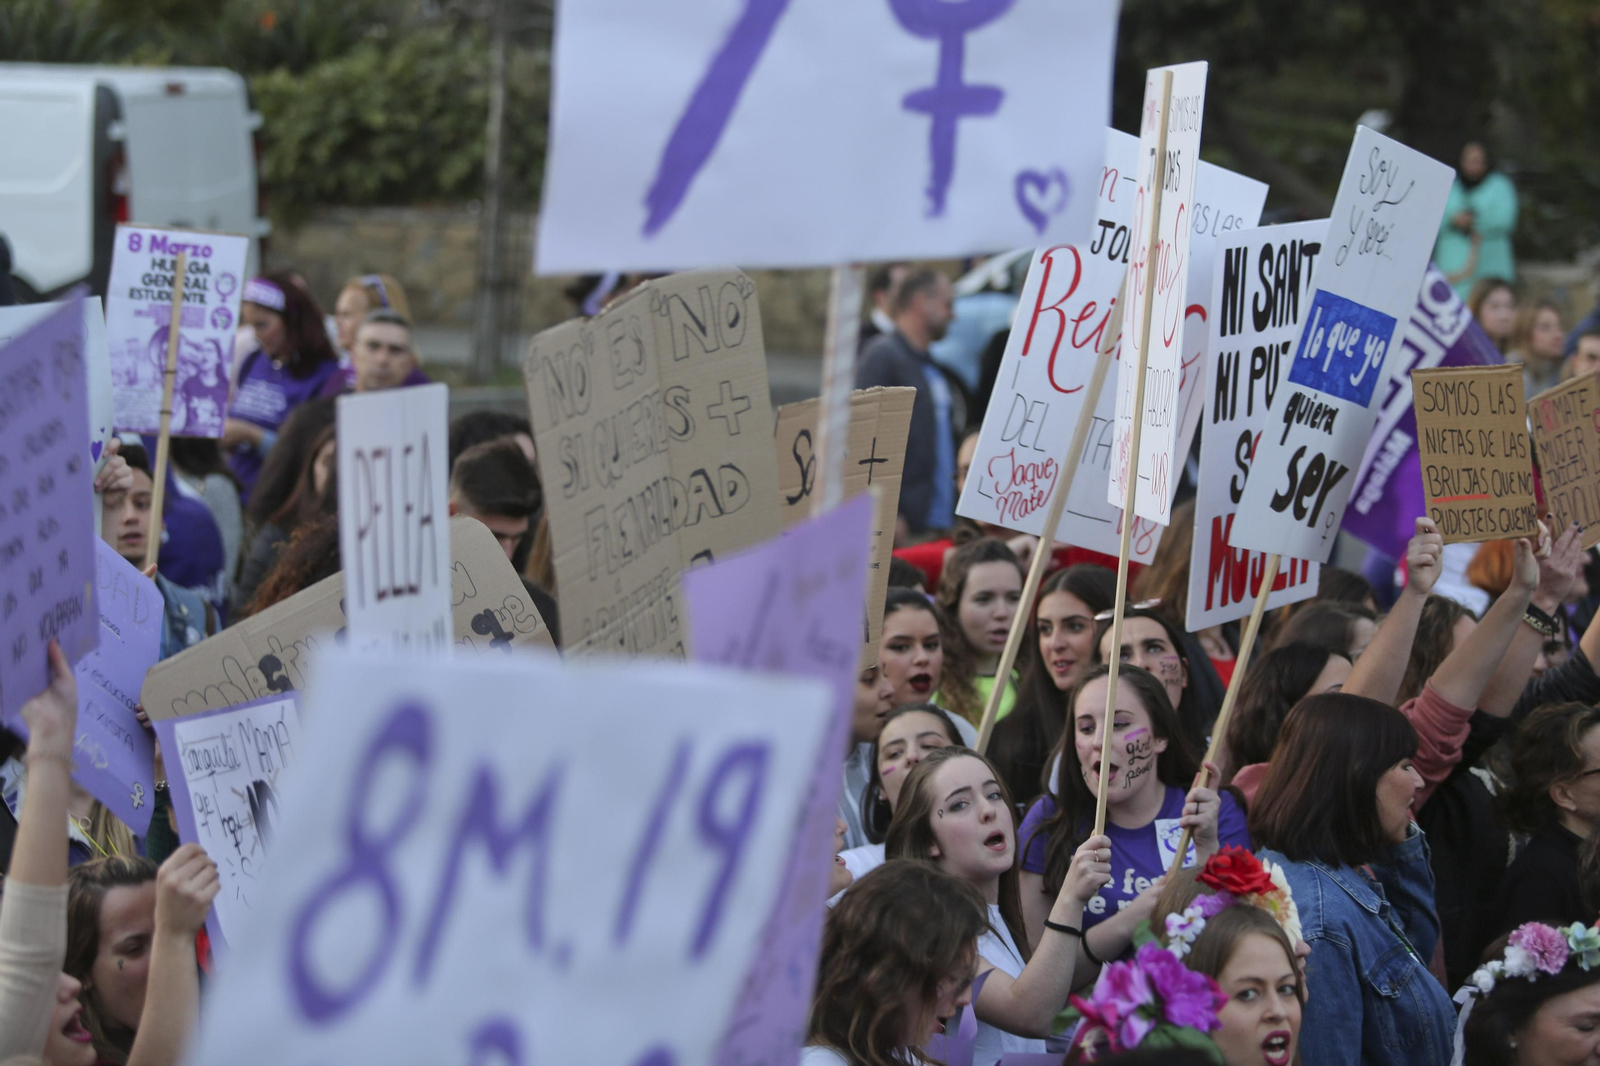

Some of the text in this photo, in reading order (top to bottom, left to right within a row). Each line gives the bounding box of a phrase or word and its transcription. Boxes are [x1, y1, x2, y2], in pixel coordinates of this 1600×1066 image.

[128, 233, 212, 258] 8 Marzo
[1220, 245, 1248, 338] NI
[607, 315, 646, 390] ES
[1303, 306, 1385, 388] lo que yo
[1213, 349, 1240, 424] NI
[1423, 380, 1516, 416] SOMOS LAS
[1001, 393, 1049, 452] DEL
[1280, 391, 1339, 447] quiera
[1425, 428, 1526, 459] NIETAS DE LAS
[1539, 426, 1587, 468] MUJER
[559, 434, 591, 498] SI
[1426, 465, 1533, 498] BRUJAS QUE NO
[355, 432, 438, 609] PELEA
[1431, 503, 1537, 535] PUDISTEIS QUEMAR
[471, 595, 537, 655] que
[1126, 736, 1153, 765] girl
